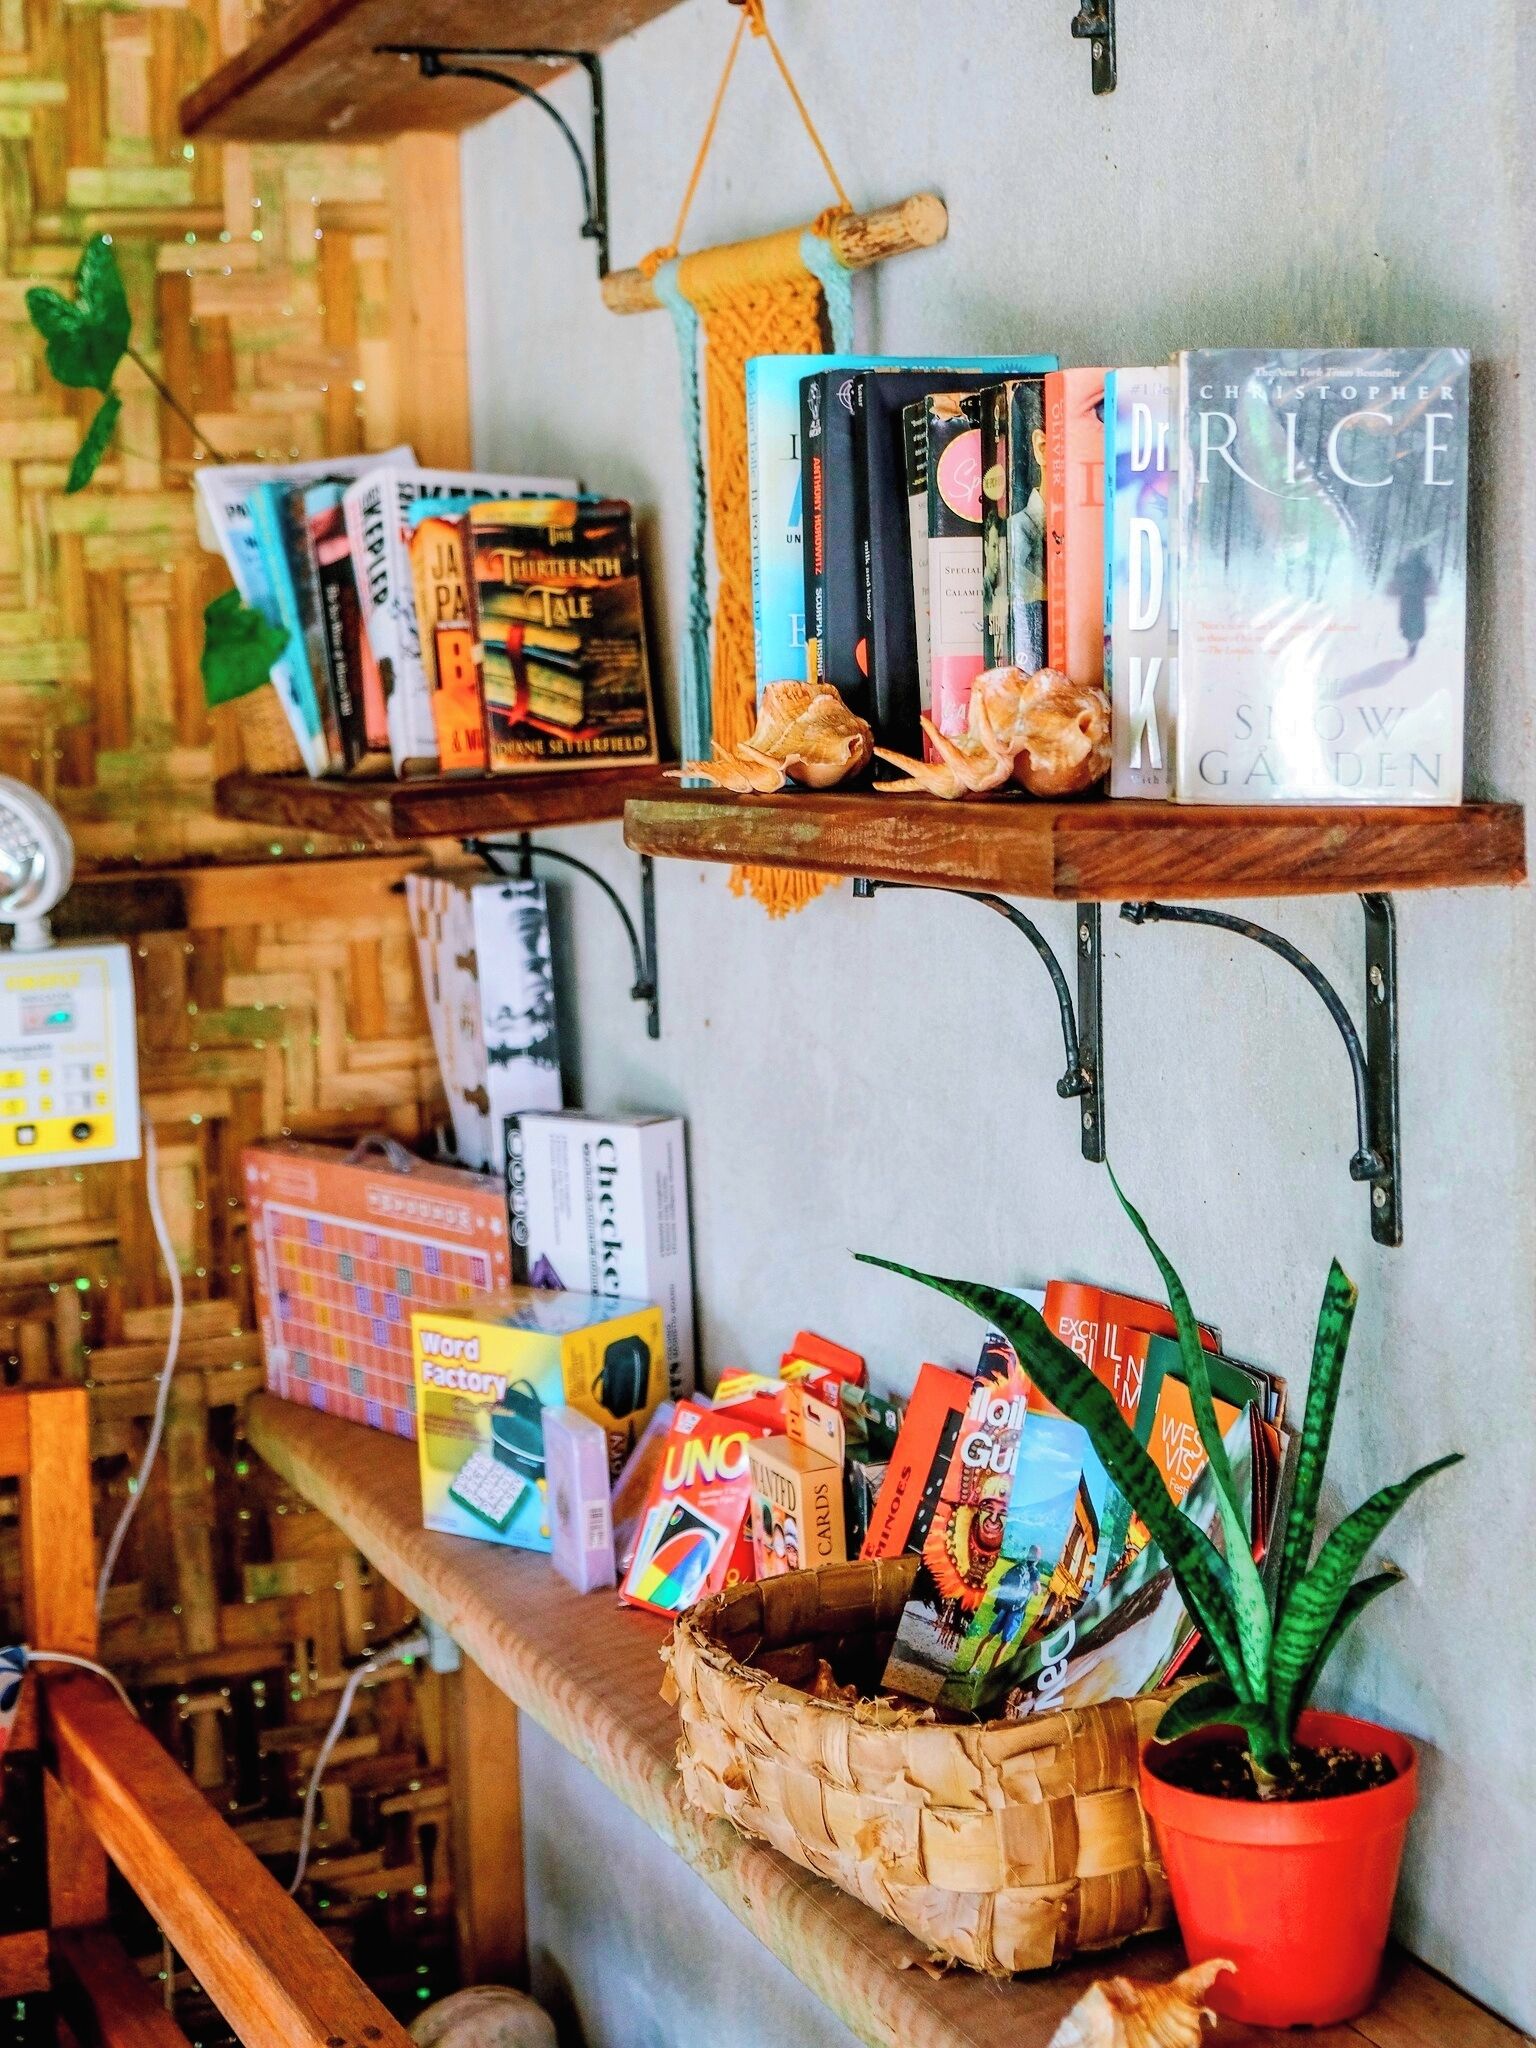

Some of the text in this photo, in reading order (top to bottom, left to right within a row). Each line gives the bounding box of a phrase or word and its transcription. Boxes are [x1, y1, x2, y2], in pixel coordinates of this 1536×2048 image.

[1199, 384, 1455, 400] CHRISTOPHER
[1051, 404, 1064, 484] OLIVER
[1131, 403, 1170, 472] Dr
[1198, 411, 1455, 501] RICE
[812, 457, 823, 576] ANTHONY HOROWITZ
[487, 549, 622, 586] THIRTEENTH
[944, 567, 982, 575] SPECIAL
[1129, 516, 1172, 631] D
[524, 586, 594, 627] TALE
[815, 587, 823, 637] SCORPIA
[865, 589, 873, 622] honey
[1129, 656, 1172, 769] K
[1198, 747, 1443, 788] GADEN
[419, 1330, 480, 1362] Word
[421, 1360, 508, 1400] Factory
[662, 1432, 750, 1492] UNO
[815, 1482, 833, 1557] CARDS
